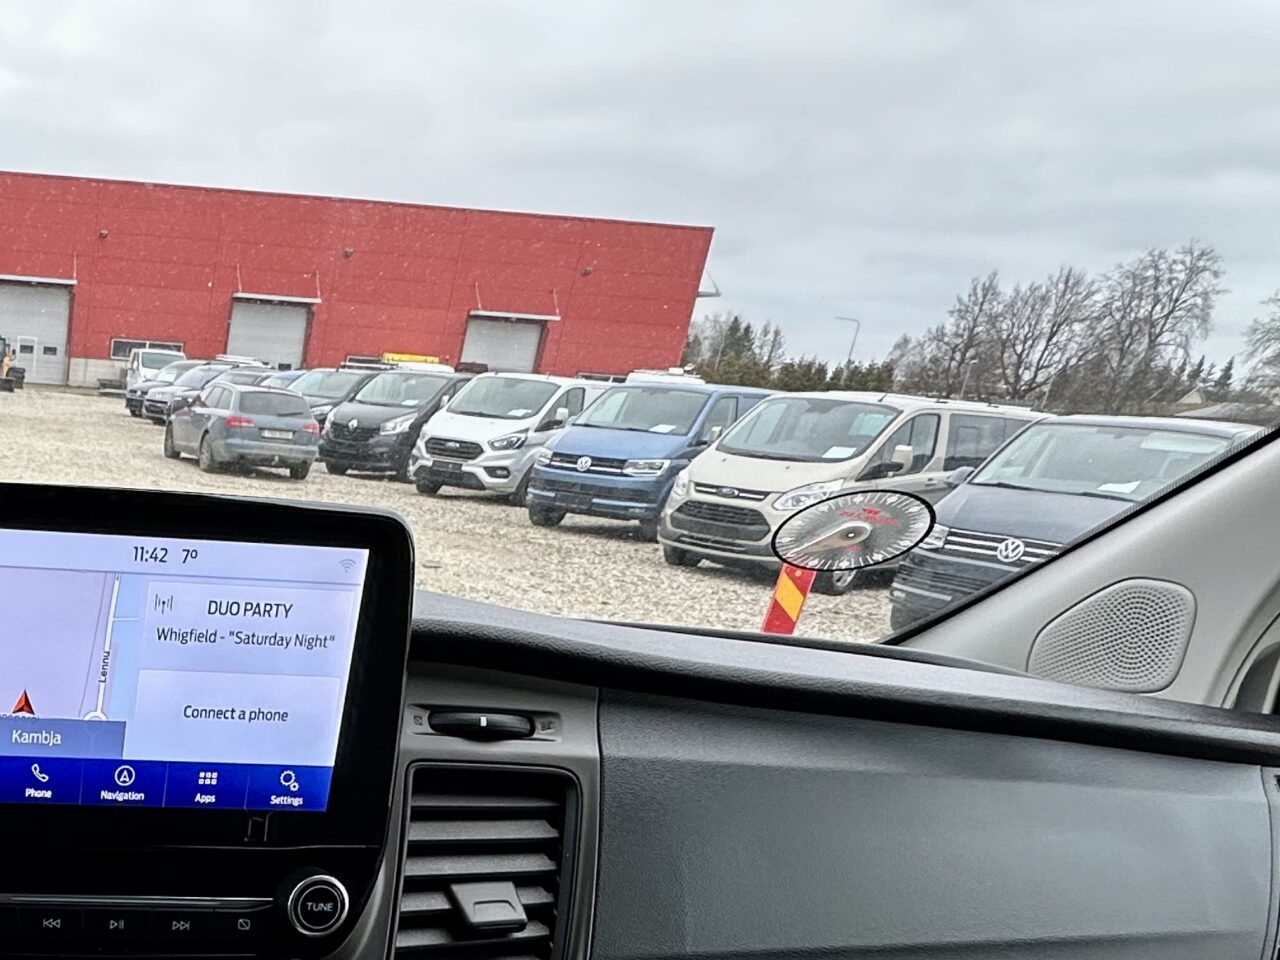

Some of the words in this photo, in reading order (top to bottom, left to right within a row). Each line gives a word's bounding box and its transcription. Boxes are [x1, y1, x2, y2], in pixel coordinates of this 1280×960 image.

[133, 546, 168, 563] 11:42
[207, 600, 240, 616] DUO
[243, 602, 293, 618] PARTY
[156, 627, 217, 645] Whigfield
[229, 630, 290, 649] "Saturday
[294, 633, 335, 650] Night"
[183, 705, 236, 720] Connect
[238, 709, 246, 720] a
[249, 708, 289, 723] phone
[12, 730, 62, 747] Kambja
[25, 788, 52, 799] Phone
[100, 790, 145, 801] Navigation
[194, 793, 216, 804] Apps
[270, 795, 303, 806] Settings
[306, 902, 334, 912] TUNE
